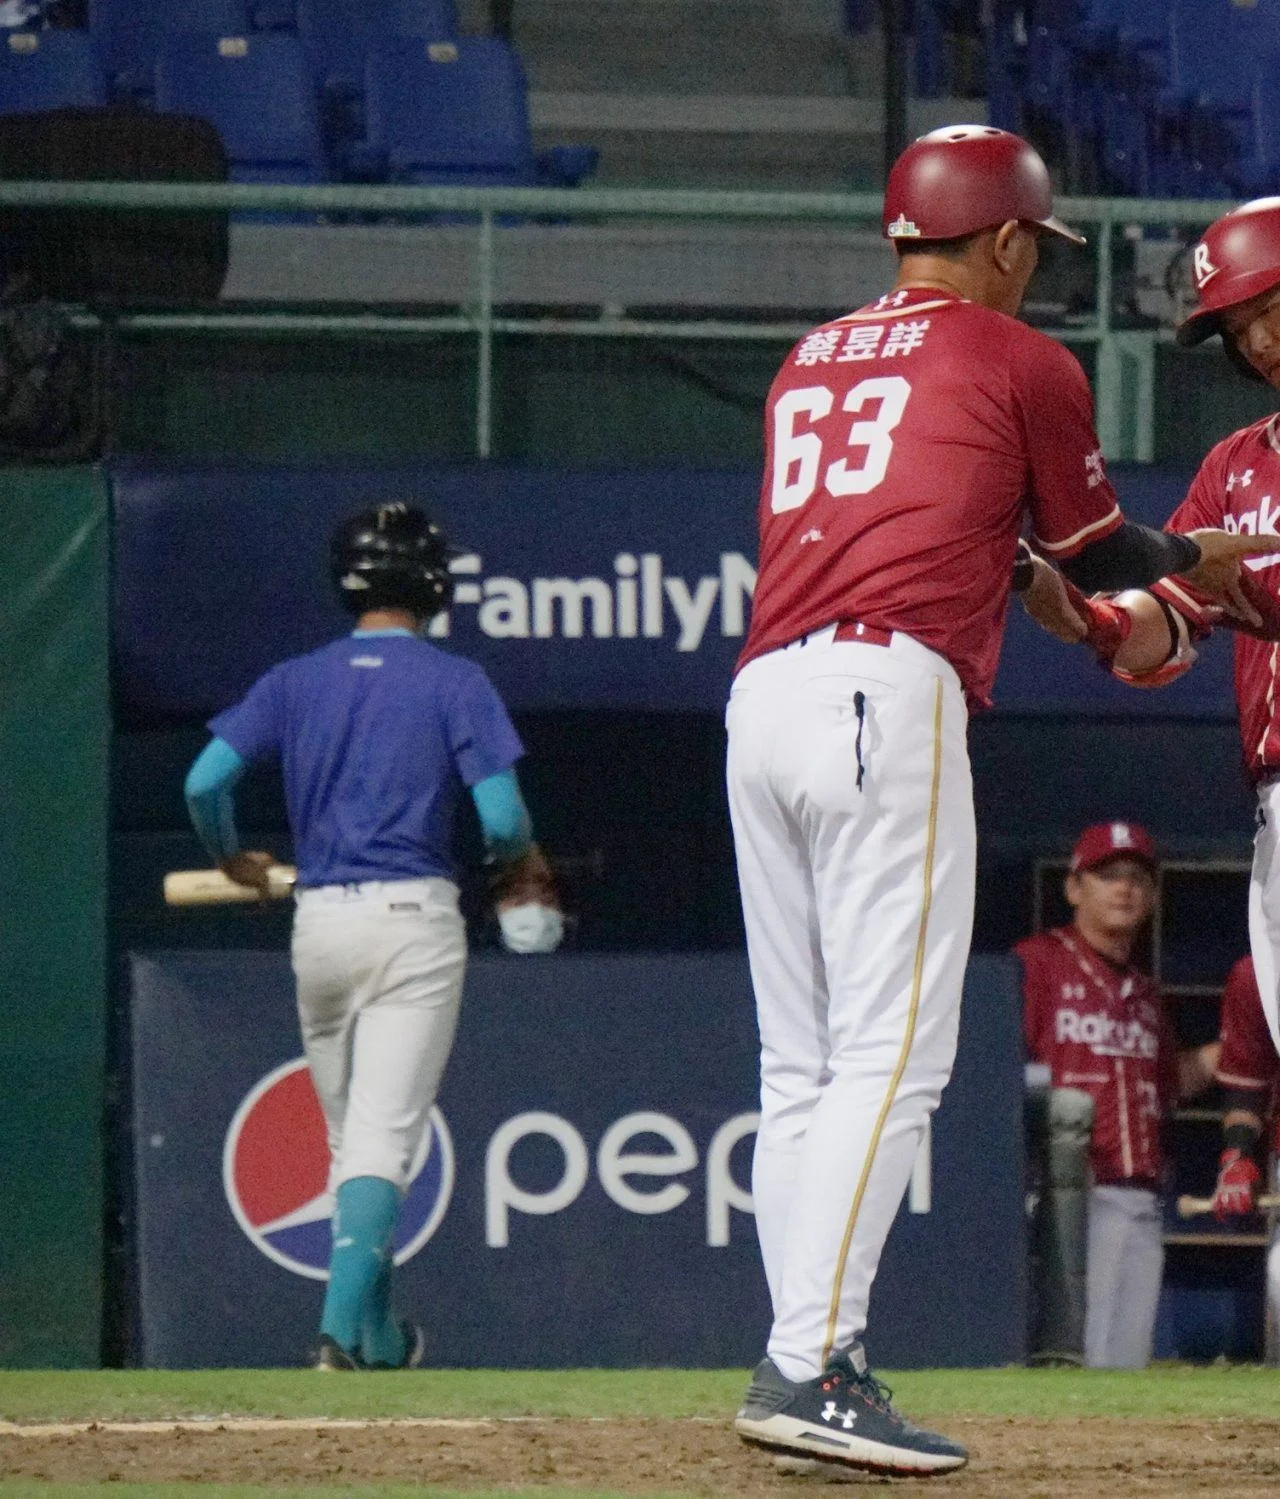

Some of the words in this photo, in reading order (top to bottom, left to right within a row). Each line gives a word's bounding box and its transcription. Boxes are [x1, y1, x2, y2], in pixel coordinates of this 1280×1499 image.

[1194, 243, 1215, 281] R
[795, 320, 930, 366] 蔡昱詳
[771, 376, 912, 515] 63
[485, 1111, 932, 1248] pepi
